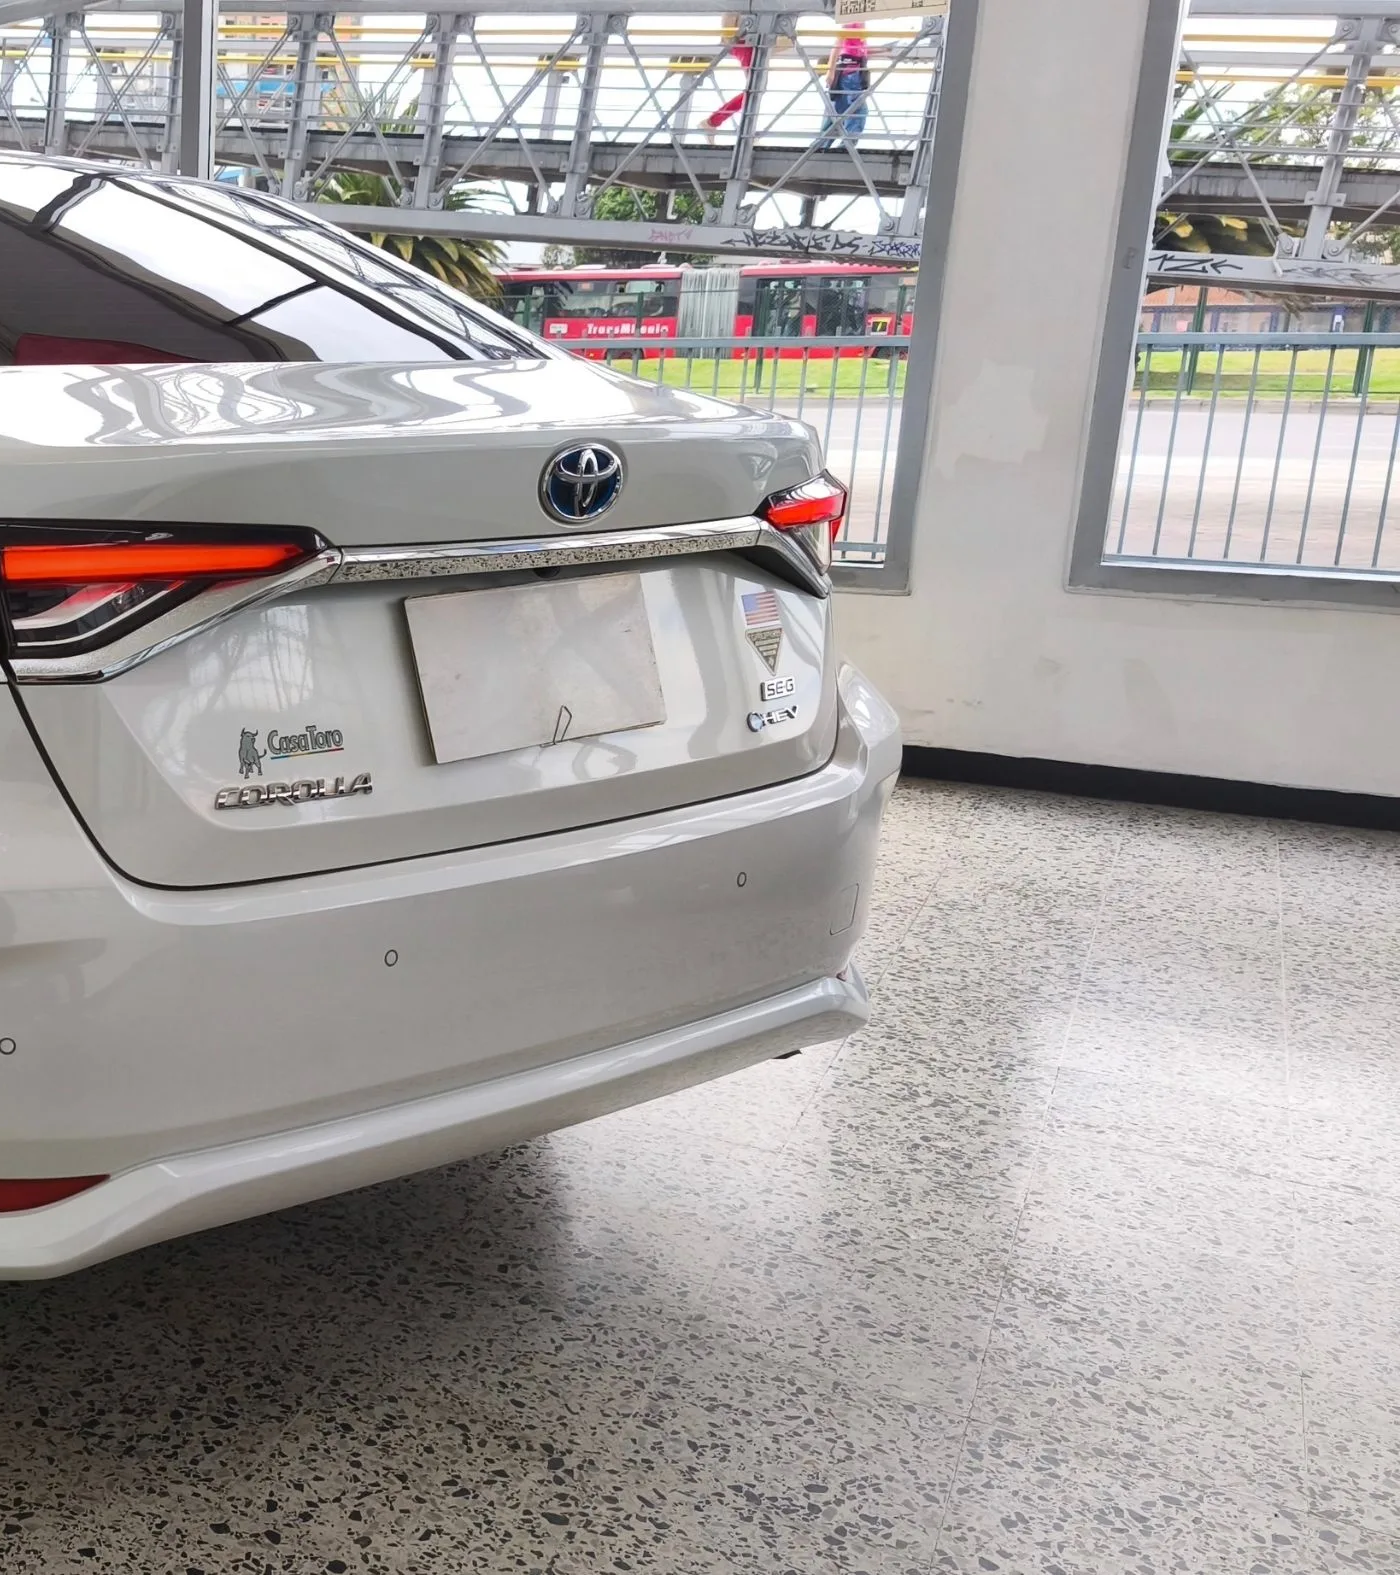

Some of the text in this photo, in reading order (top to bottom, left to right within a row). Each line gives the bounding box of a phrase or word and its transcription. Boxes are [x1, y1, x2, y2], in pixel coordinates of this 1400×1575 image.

[587, 323, 669, 335] TransMienio
[762, 705, 799, 726] HEV
[215, 772, 373, 810] COROLLA
